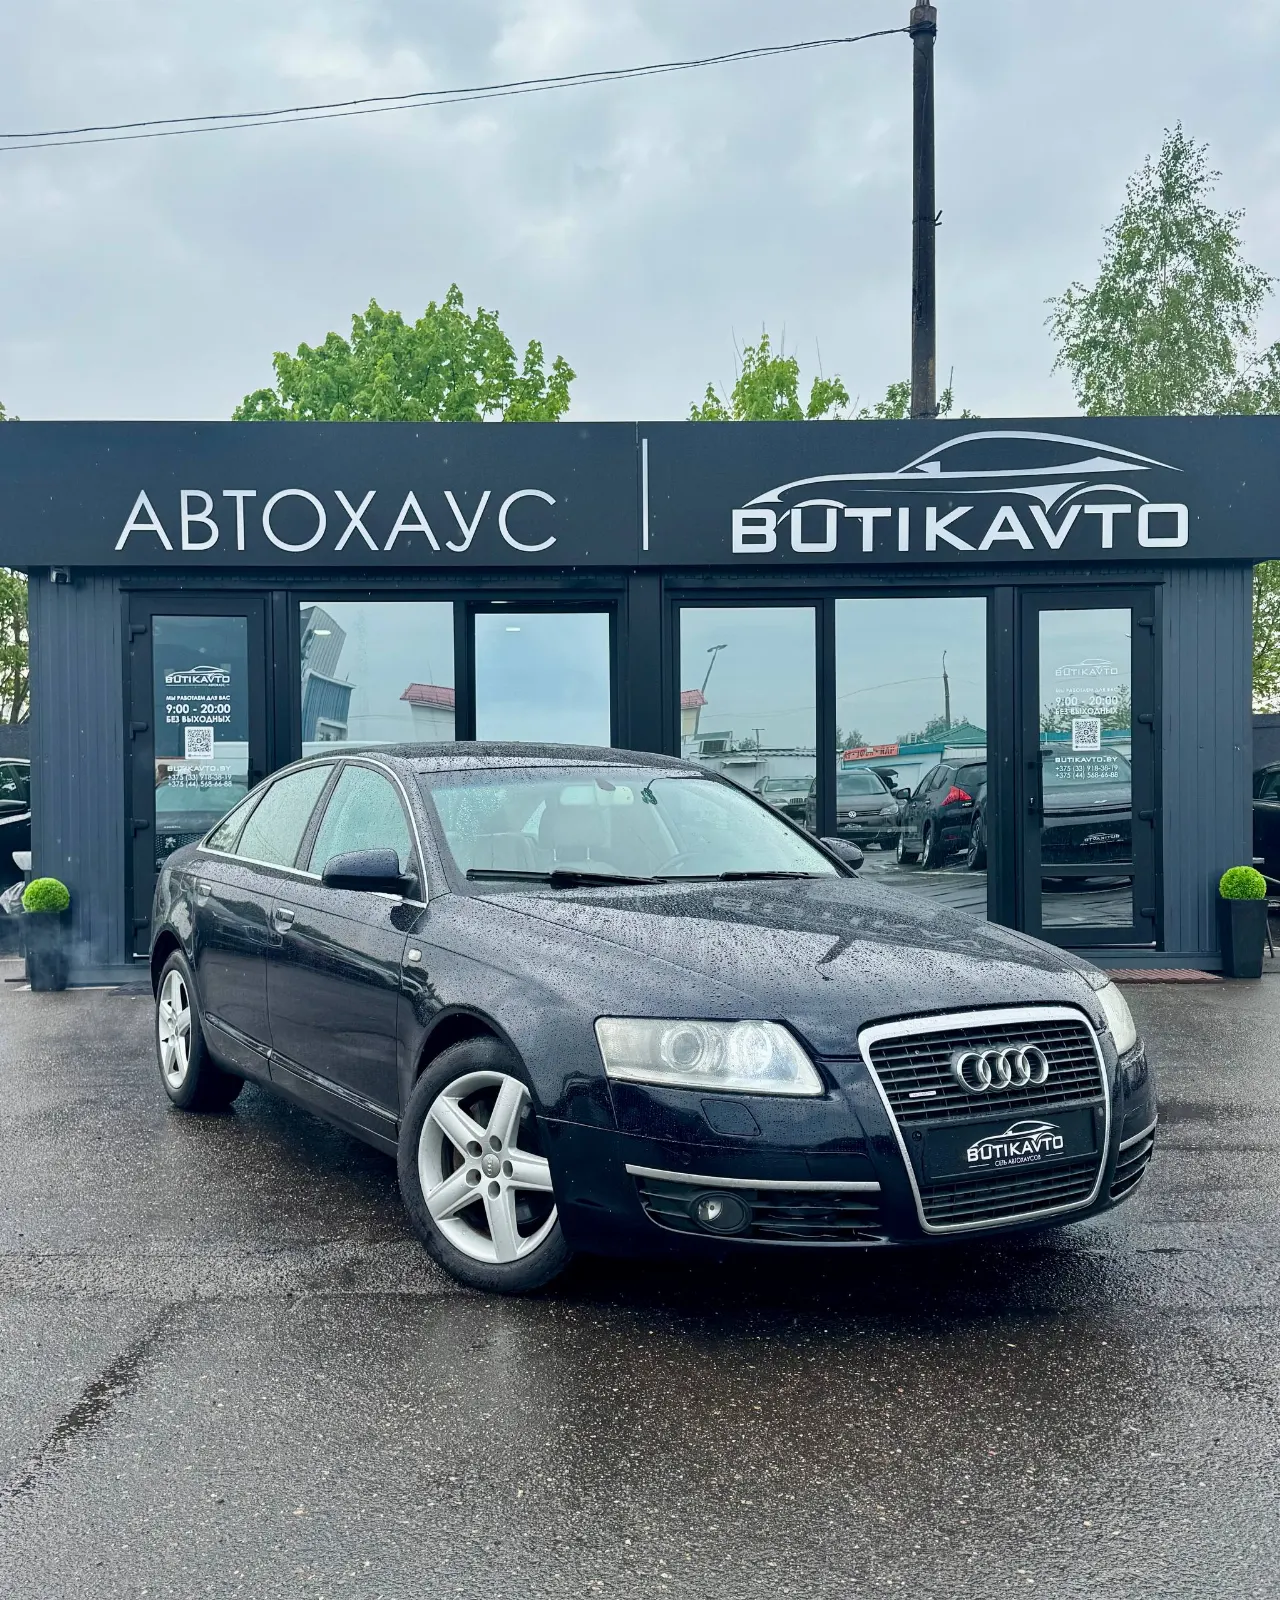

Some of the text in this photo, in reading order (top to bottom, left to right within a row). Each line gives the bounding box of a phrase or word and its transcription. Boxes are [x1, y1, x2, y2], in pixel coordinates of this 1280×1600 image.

[115, 489, 556, 552] АВТОХАУС
[732, 503, 1189, 553] BUTIKAVTO
[1055, 667, 1118, 677] BUTIKAVTO
[165, 675, 231, 684] BUTIKAVTO
[1055, 696, 1078, 706] 9:00
[1089, 695, 1118, 705] 20:00
[166, 704, 190, 714] 9:00
[200, 704, 231, 714] 20:00
[1070, 707, 1118, 715] ВЫХОДНЫХ
[1073, 764, 1085, 773] (33)
[1073, 772, 1085, 780] (44)
[967, 1136, 1064, 1162] BUTIKAVTO
